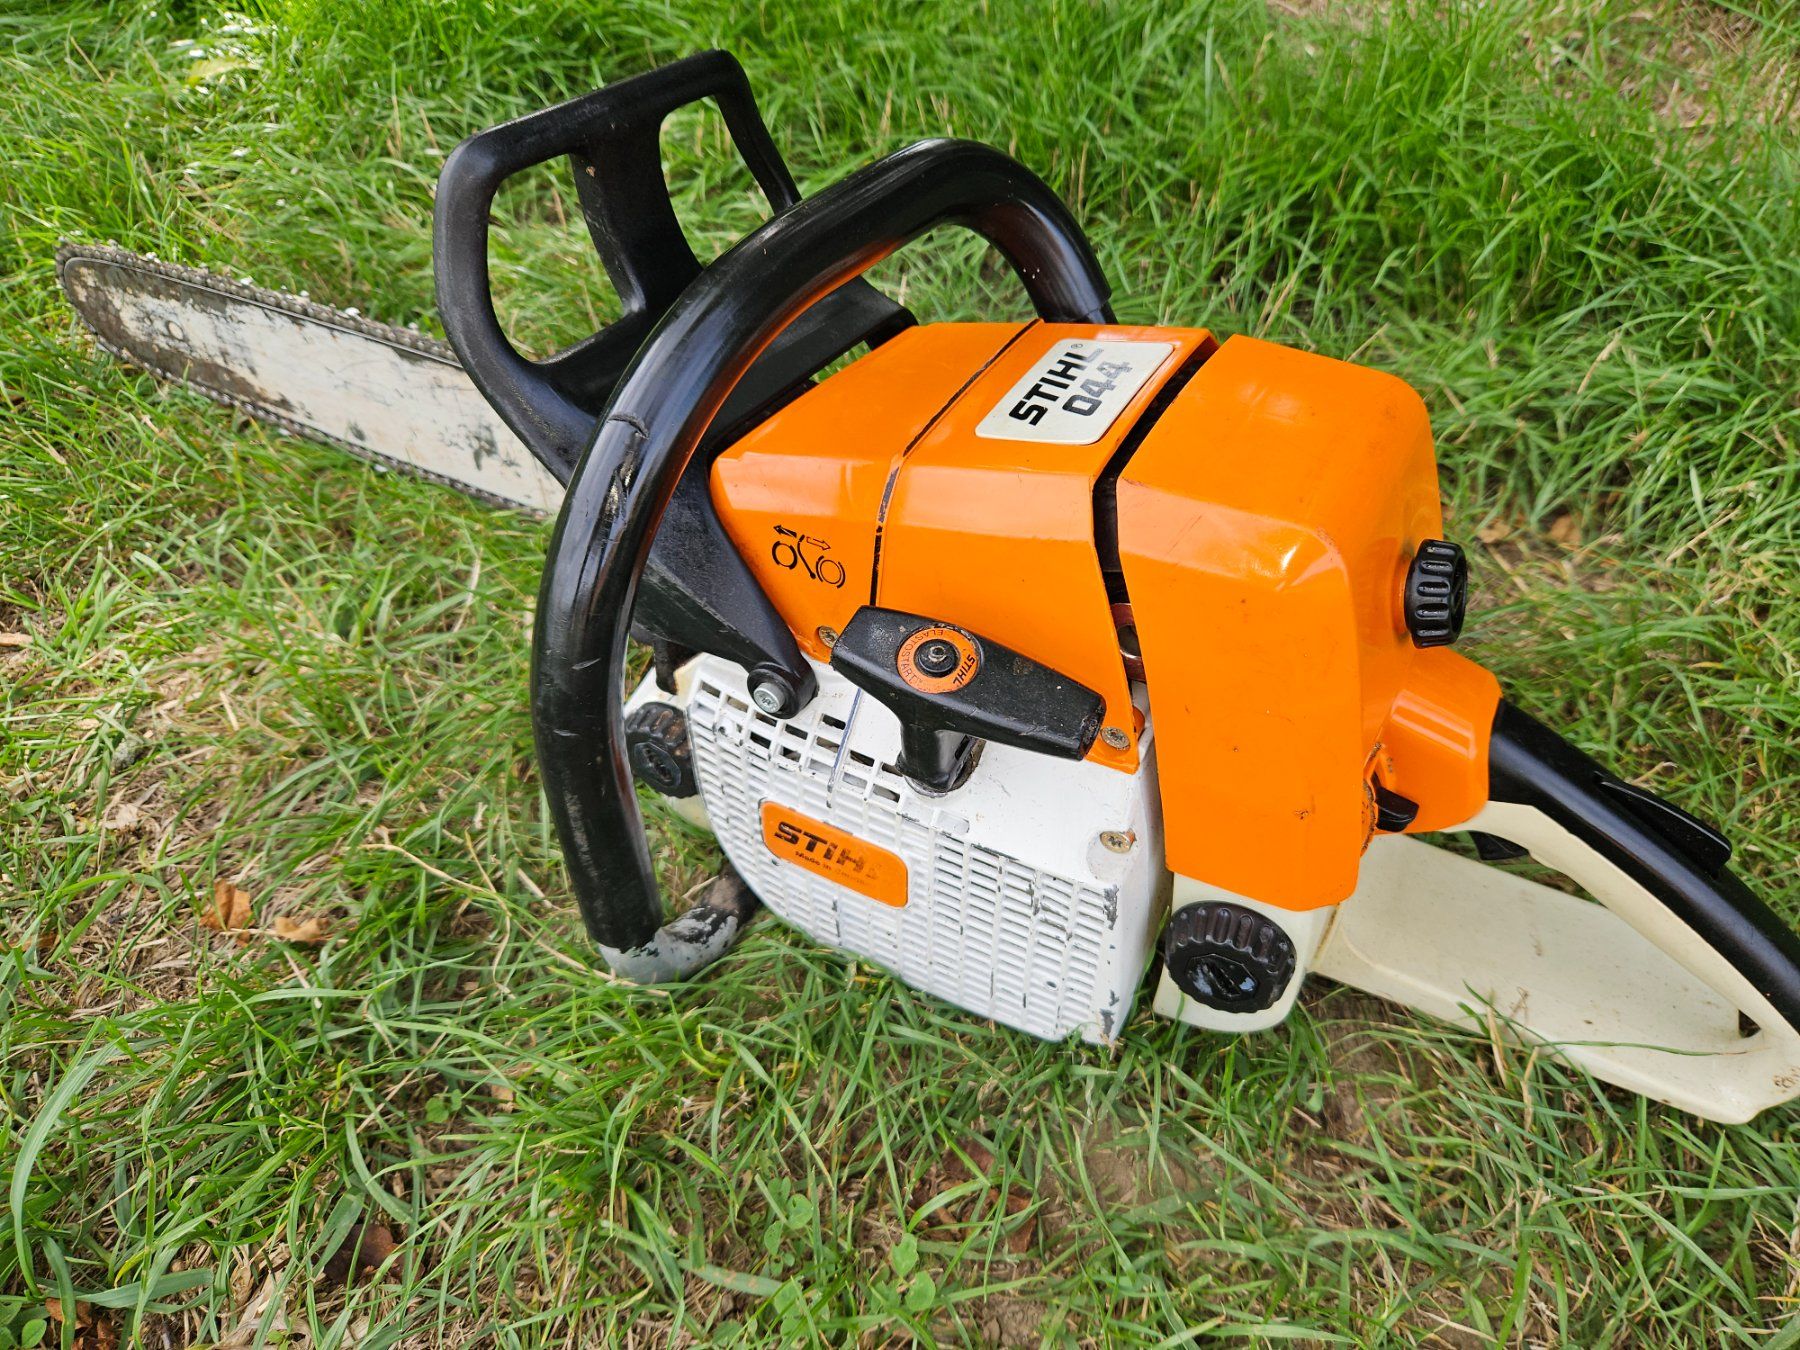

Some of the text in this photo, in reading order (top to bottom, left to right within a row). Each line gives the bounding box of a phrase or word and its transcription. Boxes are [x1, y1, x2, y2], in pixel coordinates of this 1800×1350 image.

[1062, 361, 1133, 417] 044
[953, 654, 976, 685] STIHL
[774, 821, 878, 880] STIH
